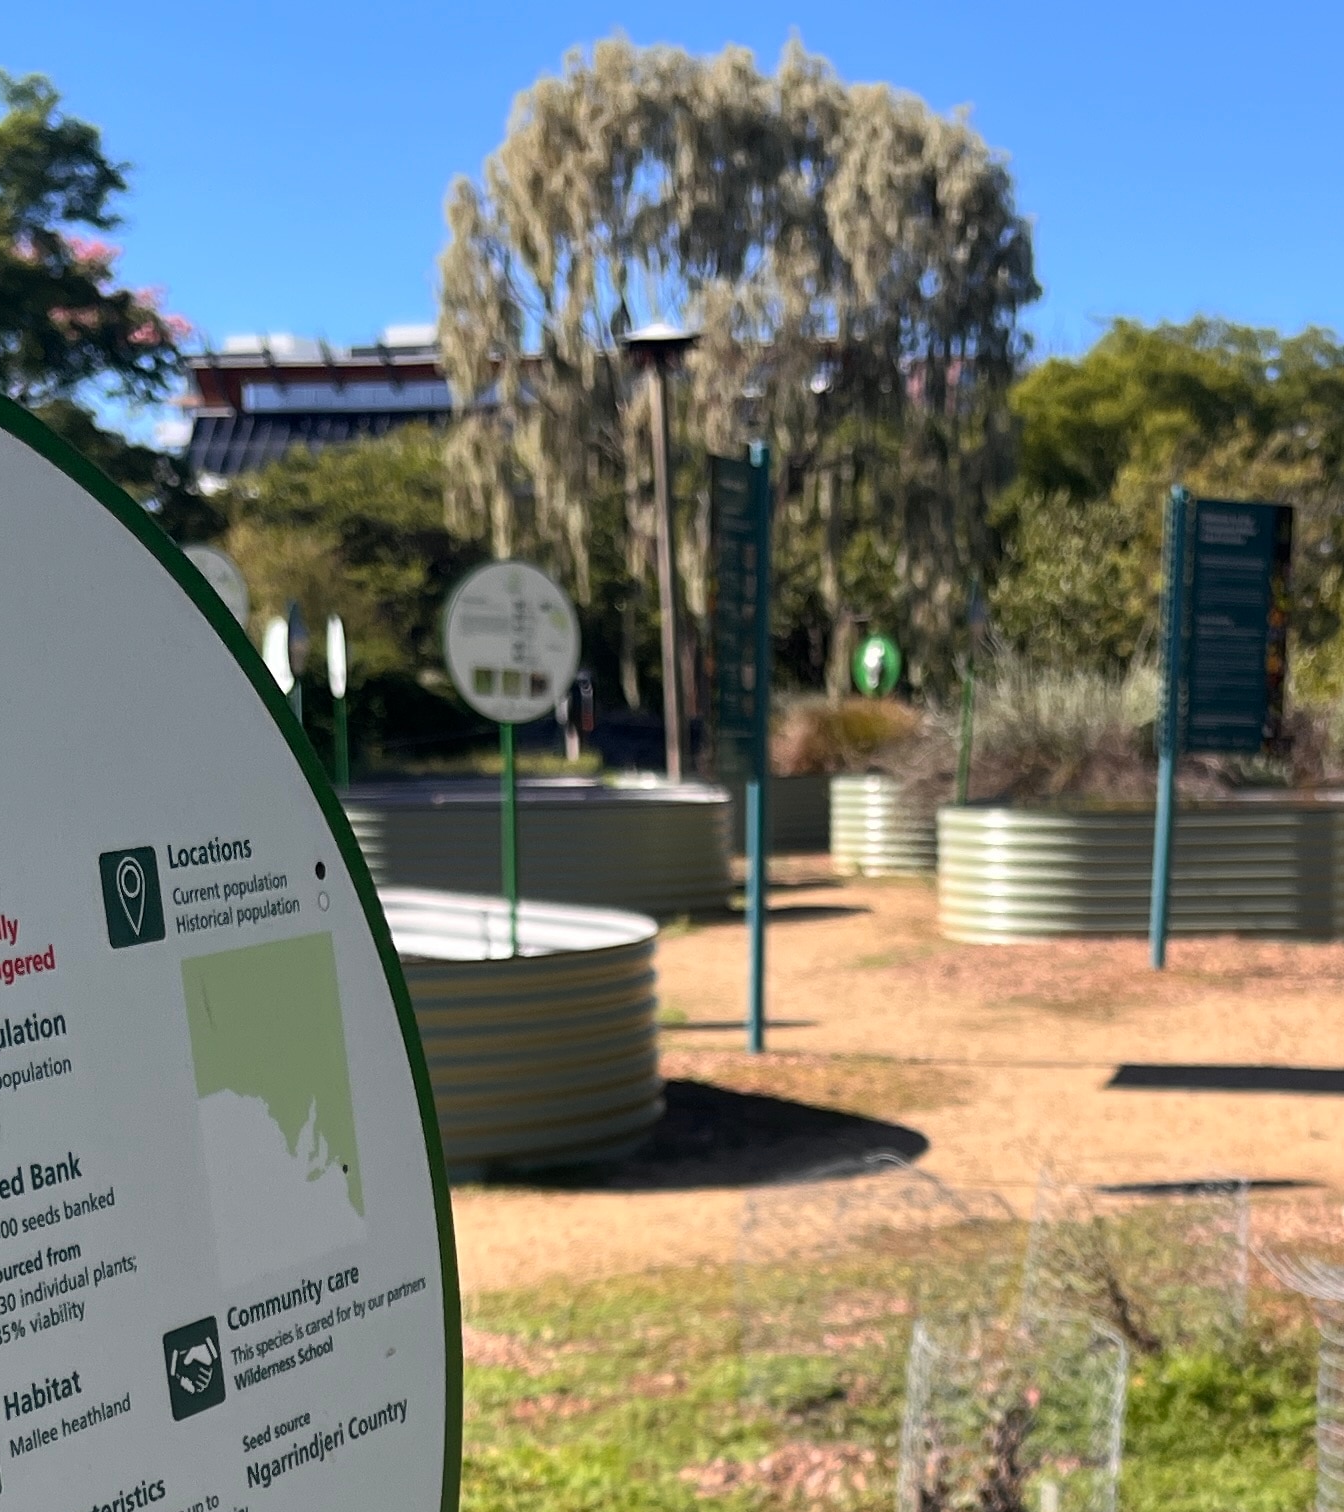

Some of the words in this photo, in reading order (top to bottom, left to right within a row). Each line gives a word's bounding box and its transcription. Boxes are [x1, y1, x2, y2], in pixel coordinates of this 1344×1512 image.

[166, 836, 252, 869] Locations
[172, 882, 221, 906] Current
[223, 873, 288, 902] population
[175, 906, 234, 934] Historical
[236, 897, 301, 927] population
[29, 1151, 82, 1191] Bank
[21, 1204, 61, 1234] seeds
[62, 1186, 115, 1220] banked
[46, 1244, 82, 1267] from
[19, 1266, 90, 1308] individual
[93, 1256, 138, 1288] plants;
[226, 1278, 323, 1331] Community
[327, 1266, 359, 1293] care
[29, 1301, 85, 1333] viability
[230, 1343, 255, 1366] This
[255, 1330, 295, 1359] species
[294, 1323, 305, 1340] is
[304, 1309, 335, 1336] cared
[335, 1306, 352, 1324] for
[352, 1300, 366, 1319] by
[367, 1293, 385, 1311] our
[386, 1277, 427, 1307] partners
[233, 1355, 297, 1391] Wilderness
[297, 1335, 334, 1365] School
[3, 1370, 82, 1421] Habitat
[9, 1427, 58, 1458] Mallee
[61, 1391, 131, 1437] heathland
[242, 1424, 272, 1453] Seed
[273, 1412, 311, 1439] source
[246, 1422, 345, 1489] Ngarrindjeri
[348, 1398, 408, 1440] Country
[205, 1495, 220, 1511] to
